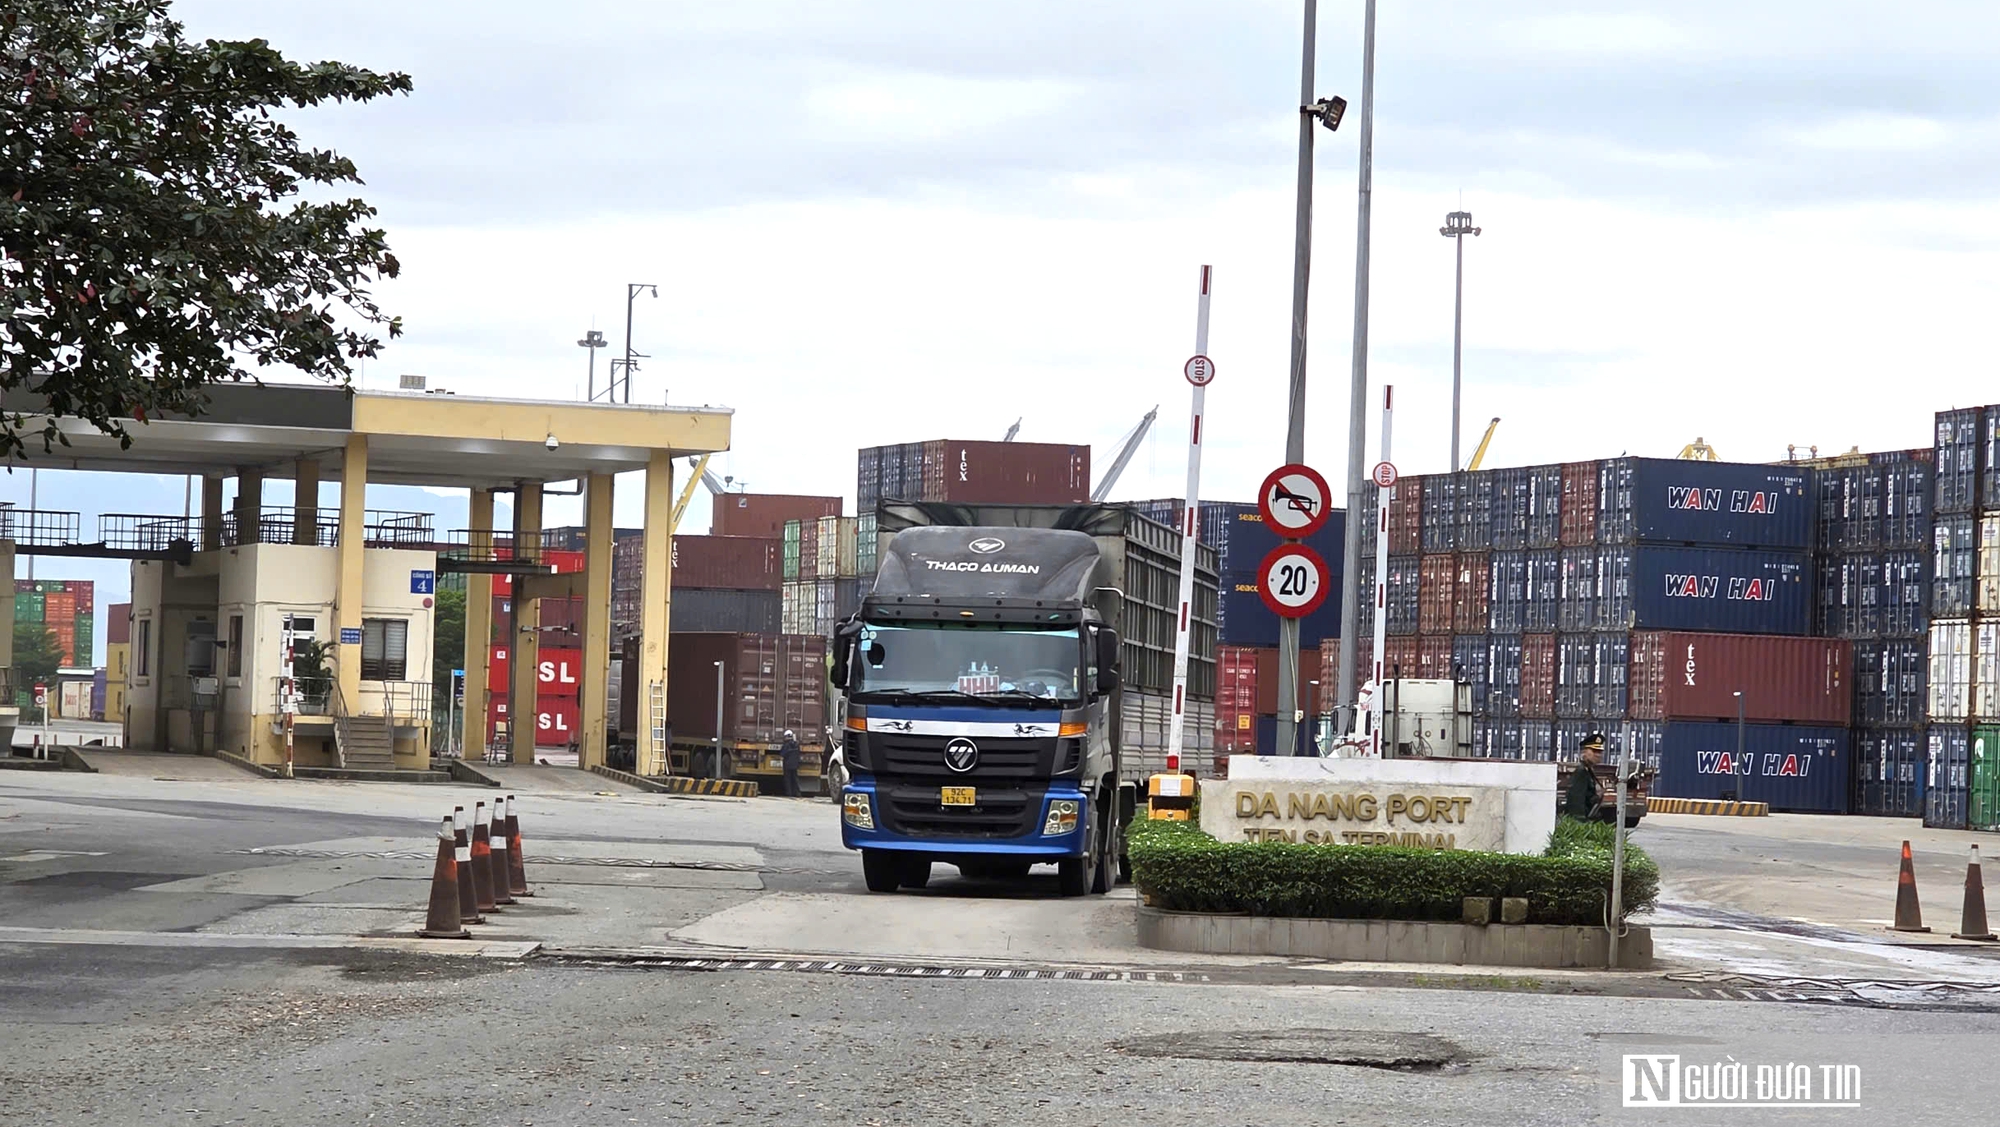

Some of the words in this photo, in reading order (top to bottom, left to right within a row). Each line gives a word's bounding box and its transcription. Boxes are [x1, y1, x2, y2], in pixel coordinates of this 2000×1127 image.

[1194, 359, 1205, 382] STOP
[959, 449, 969, 481] tex
[1381, 465, 1391, 484] STOP
[1668, 486, 1722, 511] WAN
[1730, 490, 1778, 514] HAI
[926, 560, 979, 572] THACO
[980, 563, 1040, 574] AUMAN
[417, 580, 427, 593] 4
[1279, 565, 1307, 596] 20
[1665, 574, 1719, 598] WAN
[1727, 577, 1775, 600] HAI
[1684, 643, 1696, 686] tex
[1697, 751, 1753, 775] WAN
[1762, 754, 1811, 776] HAI
[951, 788, 966, 796] 92C
[1236, 791, 1281, 819] DA
[1288, 792, 1378, 821] NANG
[1386, 794, 1472, 823] PORT
[1244, 828, 1296, 844] TIEN
[1304, 829, 1335, 844] SA
